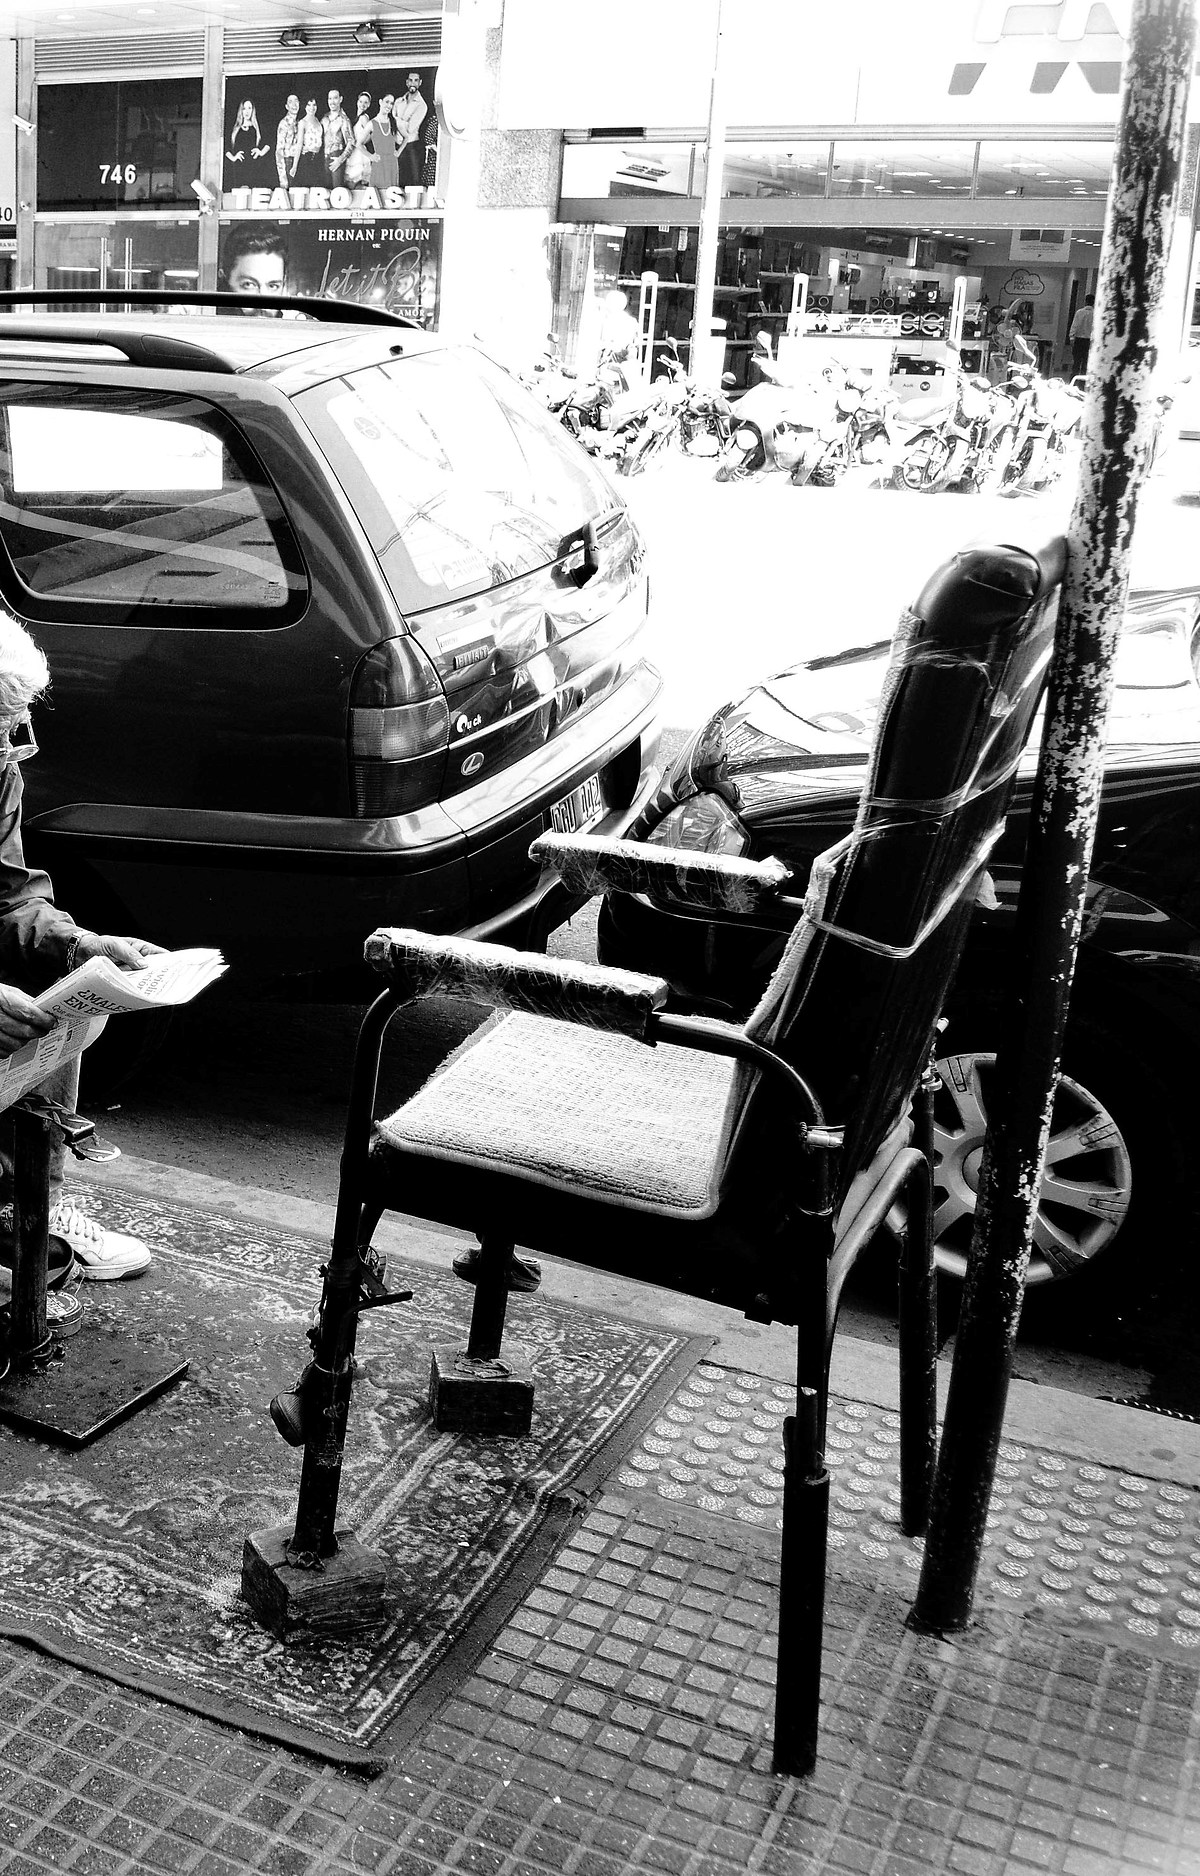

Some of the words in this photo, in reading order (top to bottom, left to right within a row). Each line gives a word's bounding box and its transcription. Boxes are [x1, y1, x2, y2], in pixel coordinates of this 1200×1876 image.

[99, 163, 137, 185] 746
[231, 186, 349, 210] TEATRO
[318, 229, 375, 241] HERNAN
[381, 228, 430, 242] PIQUIN
[399, 309, 425, 317] AMOR
[63, 995, 89, 1010] EN
